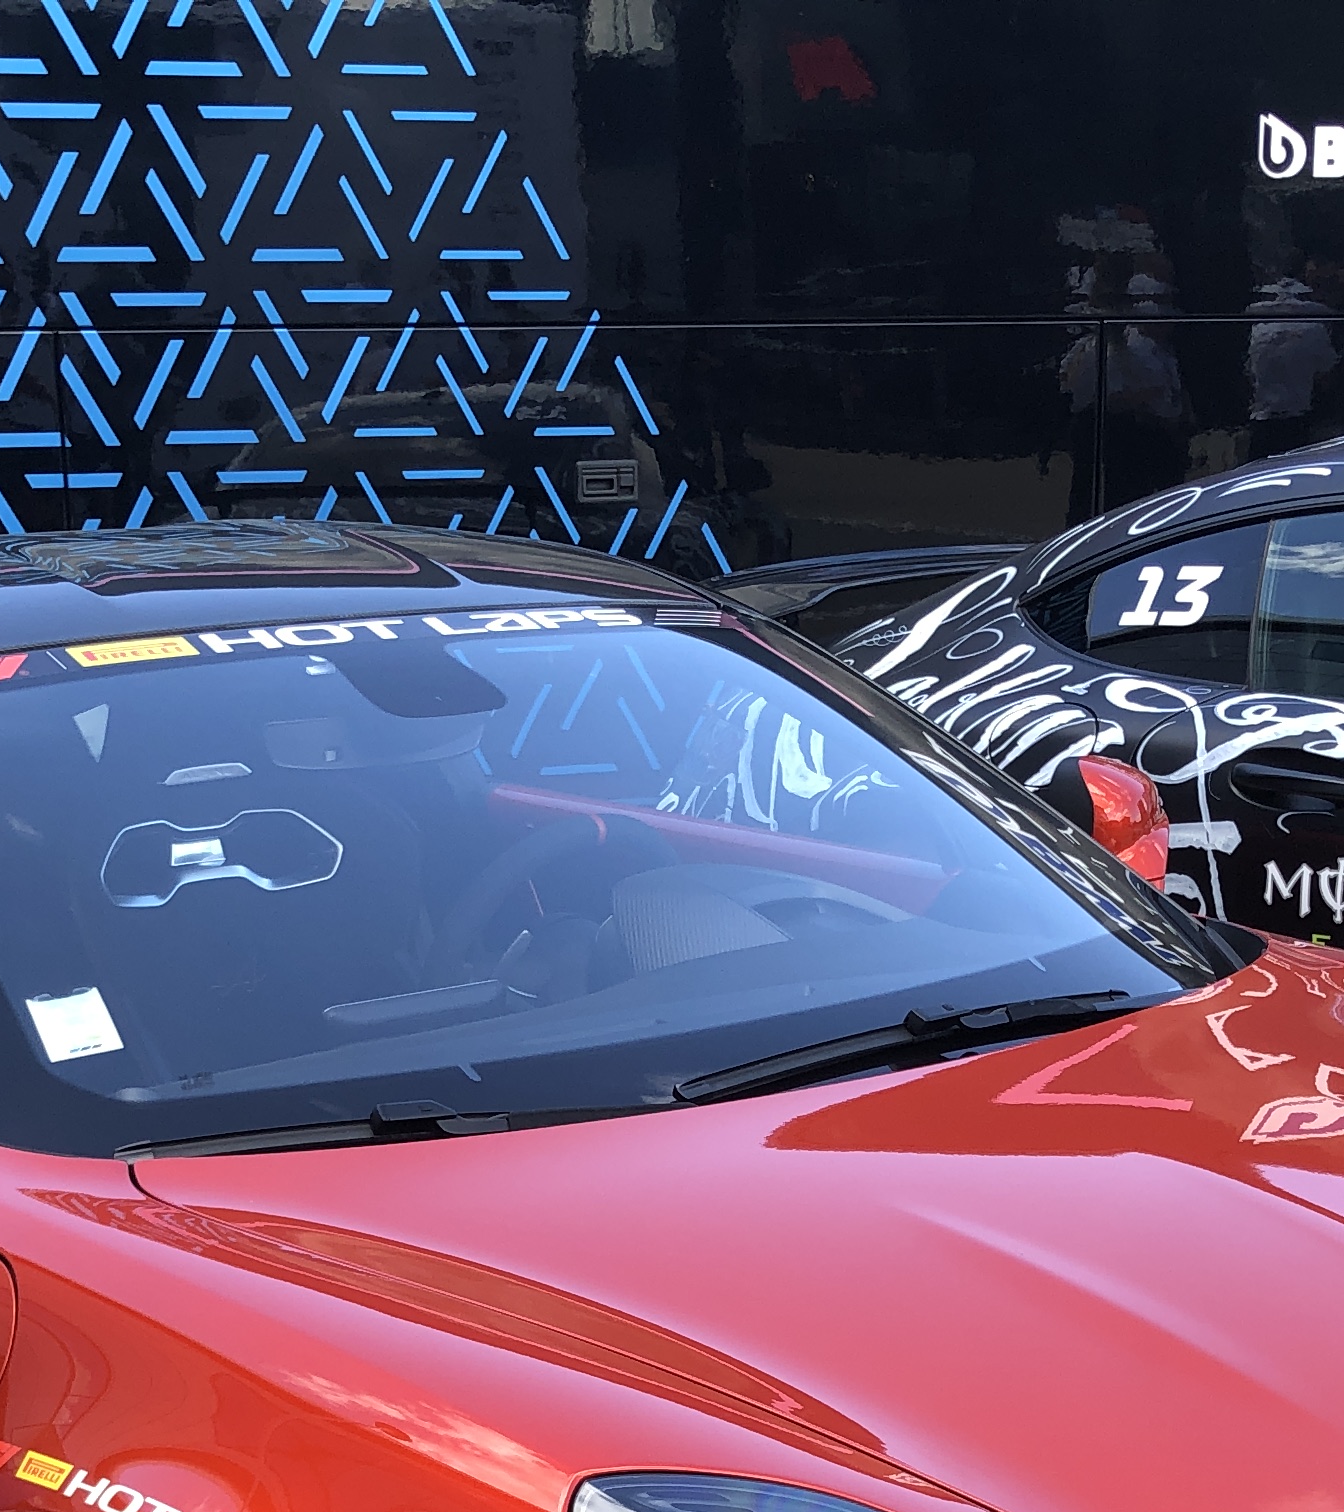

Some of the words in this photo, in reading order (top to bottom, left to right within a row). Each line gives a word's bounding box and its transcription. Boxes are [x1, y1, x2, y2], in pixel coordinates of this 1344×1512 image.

[1118, 565, 1225, 627] 13
[198, 619, 405, 654] HOT
[22, 1457, 67, 1484] PIRELLI
